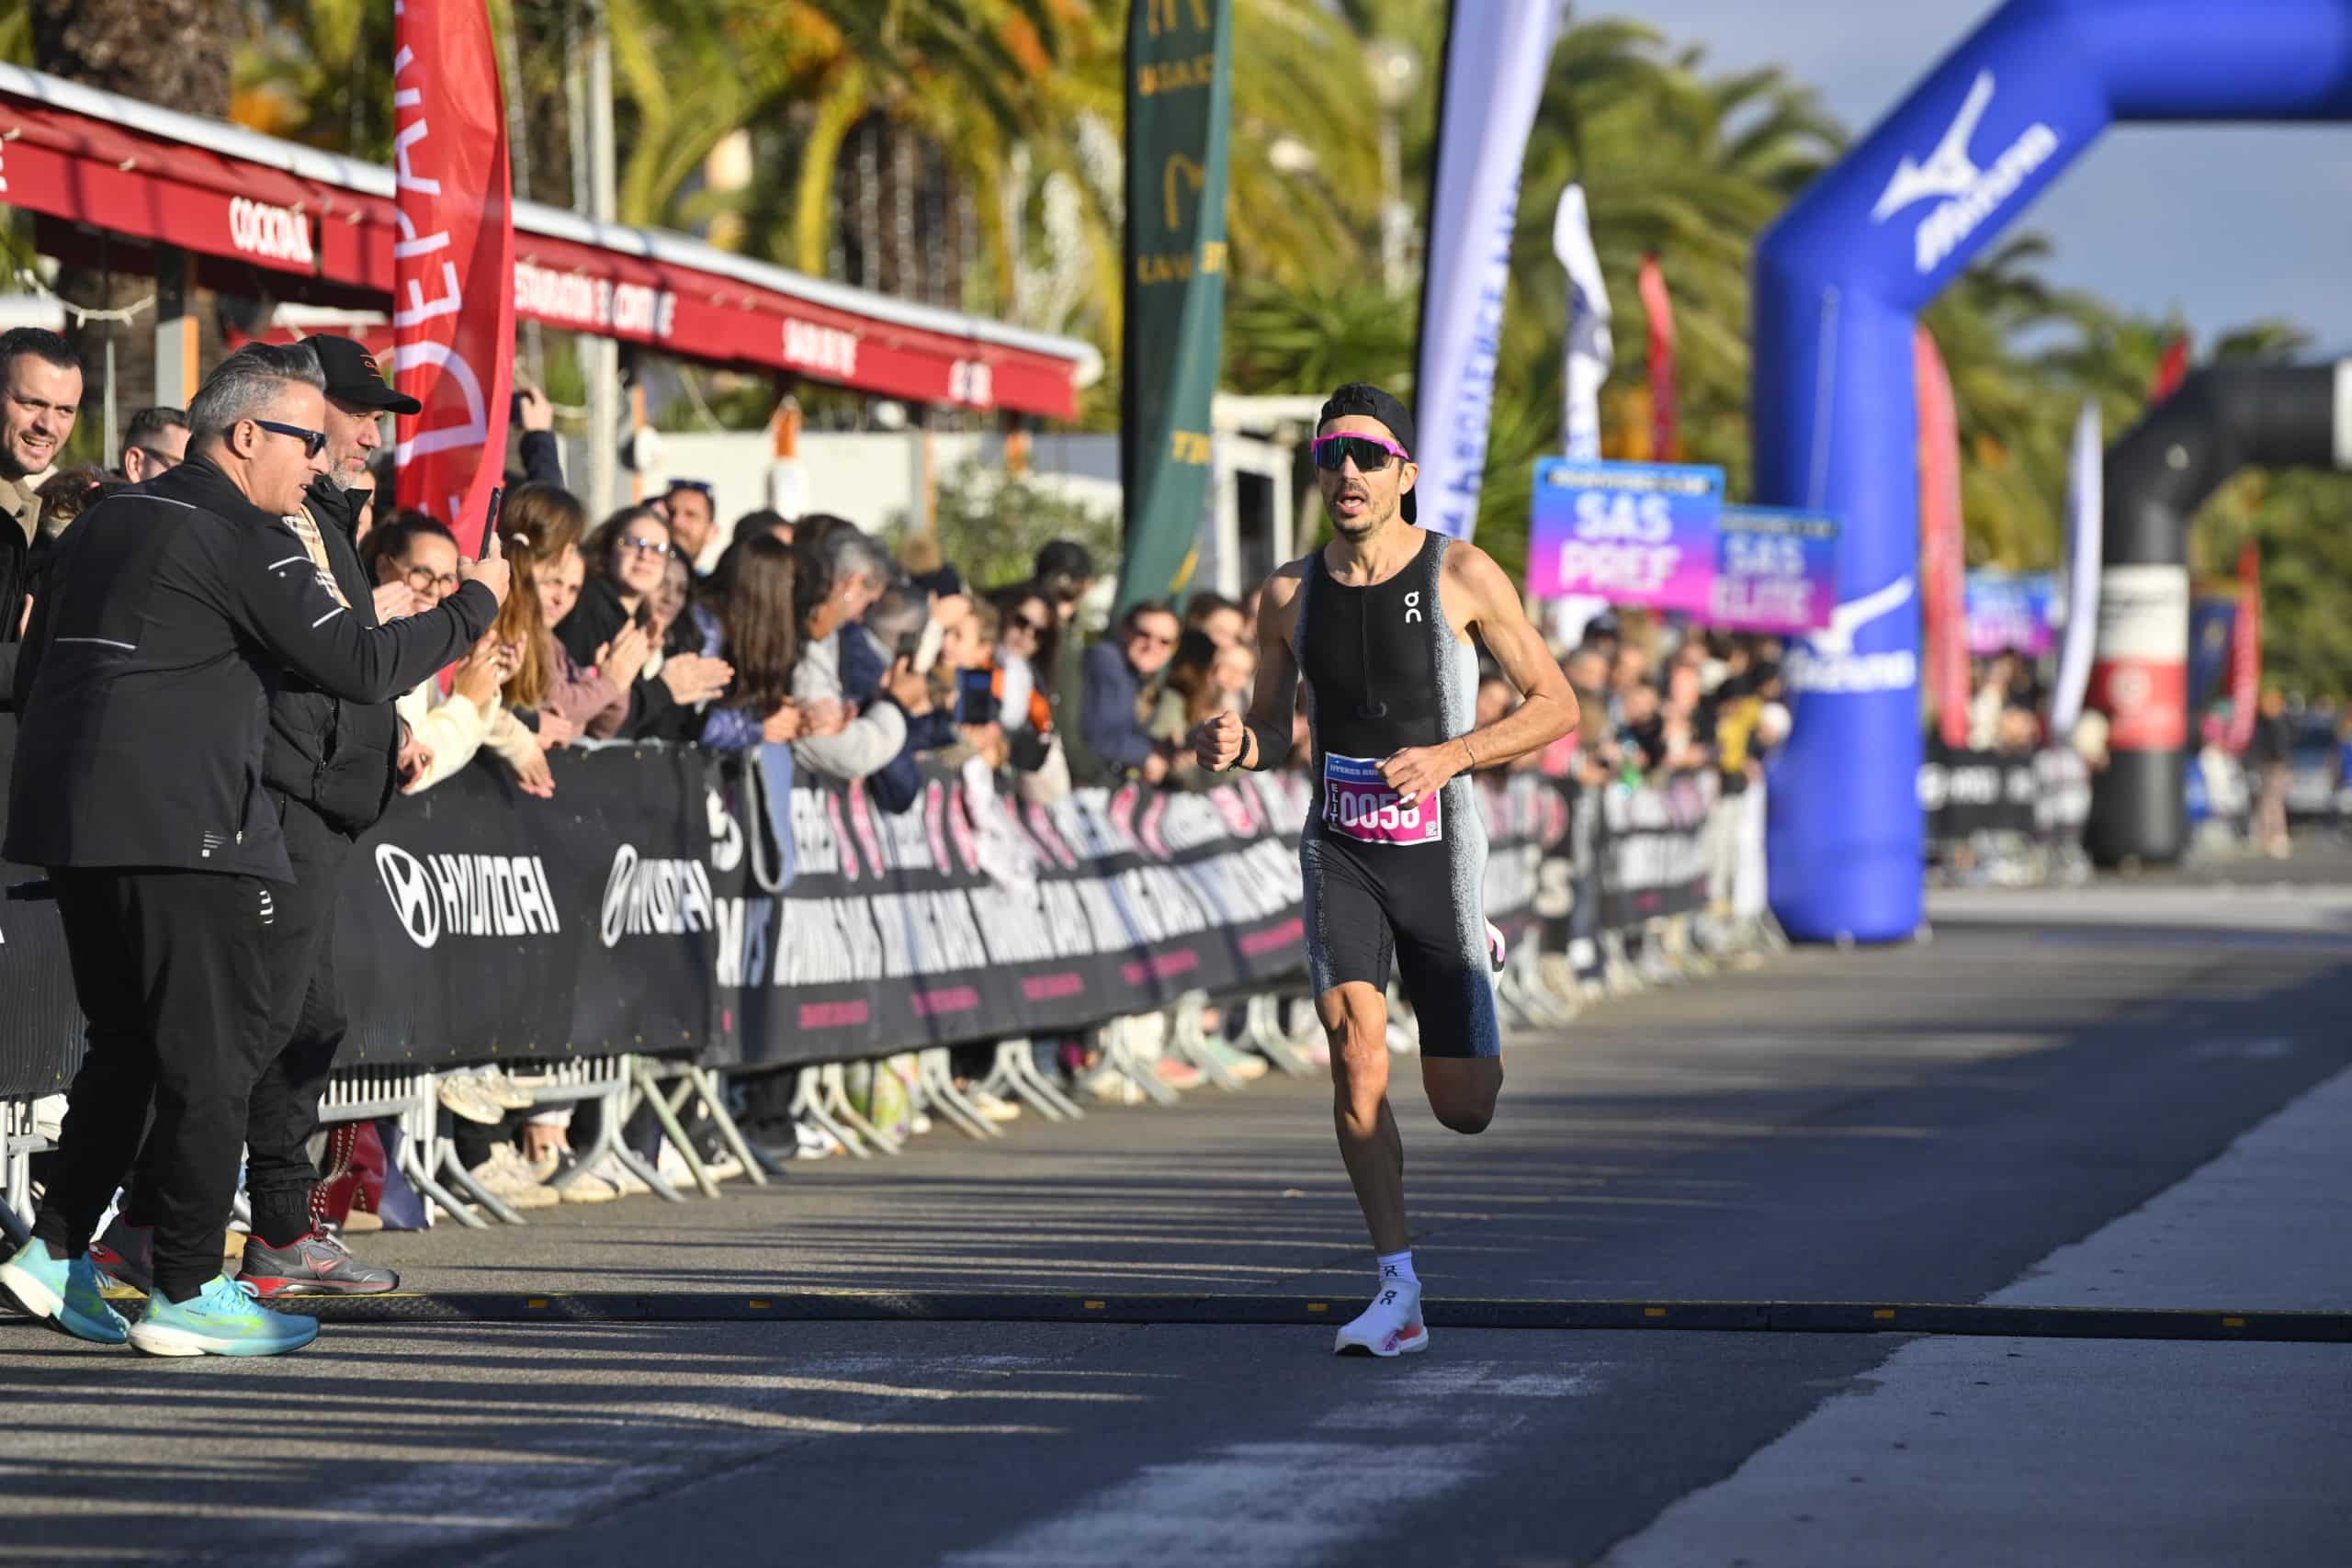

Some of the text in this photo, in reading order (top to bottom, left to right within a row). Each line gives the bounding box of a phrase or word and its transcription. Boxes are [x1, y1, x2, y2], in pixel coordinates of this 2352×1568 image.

[1574, 491, 1674, 542] SAS
[427, 853, 560, 936] HYUNDAI
[627, 858, 713, 935] HYUNDAI
